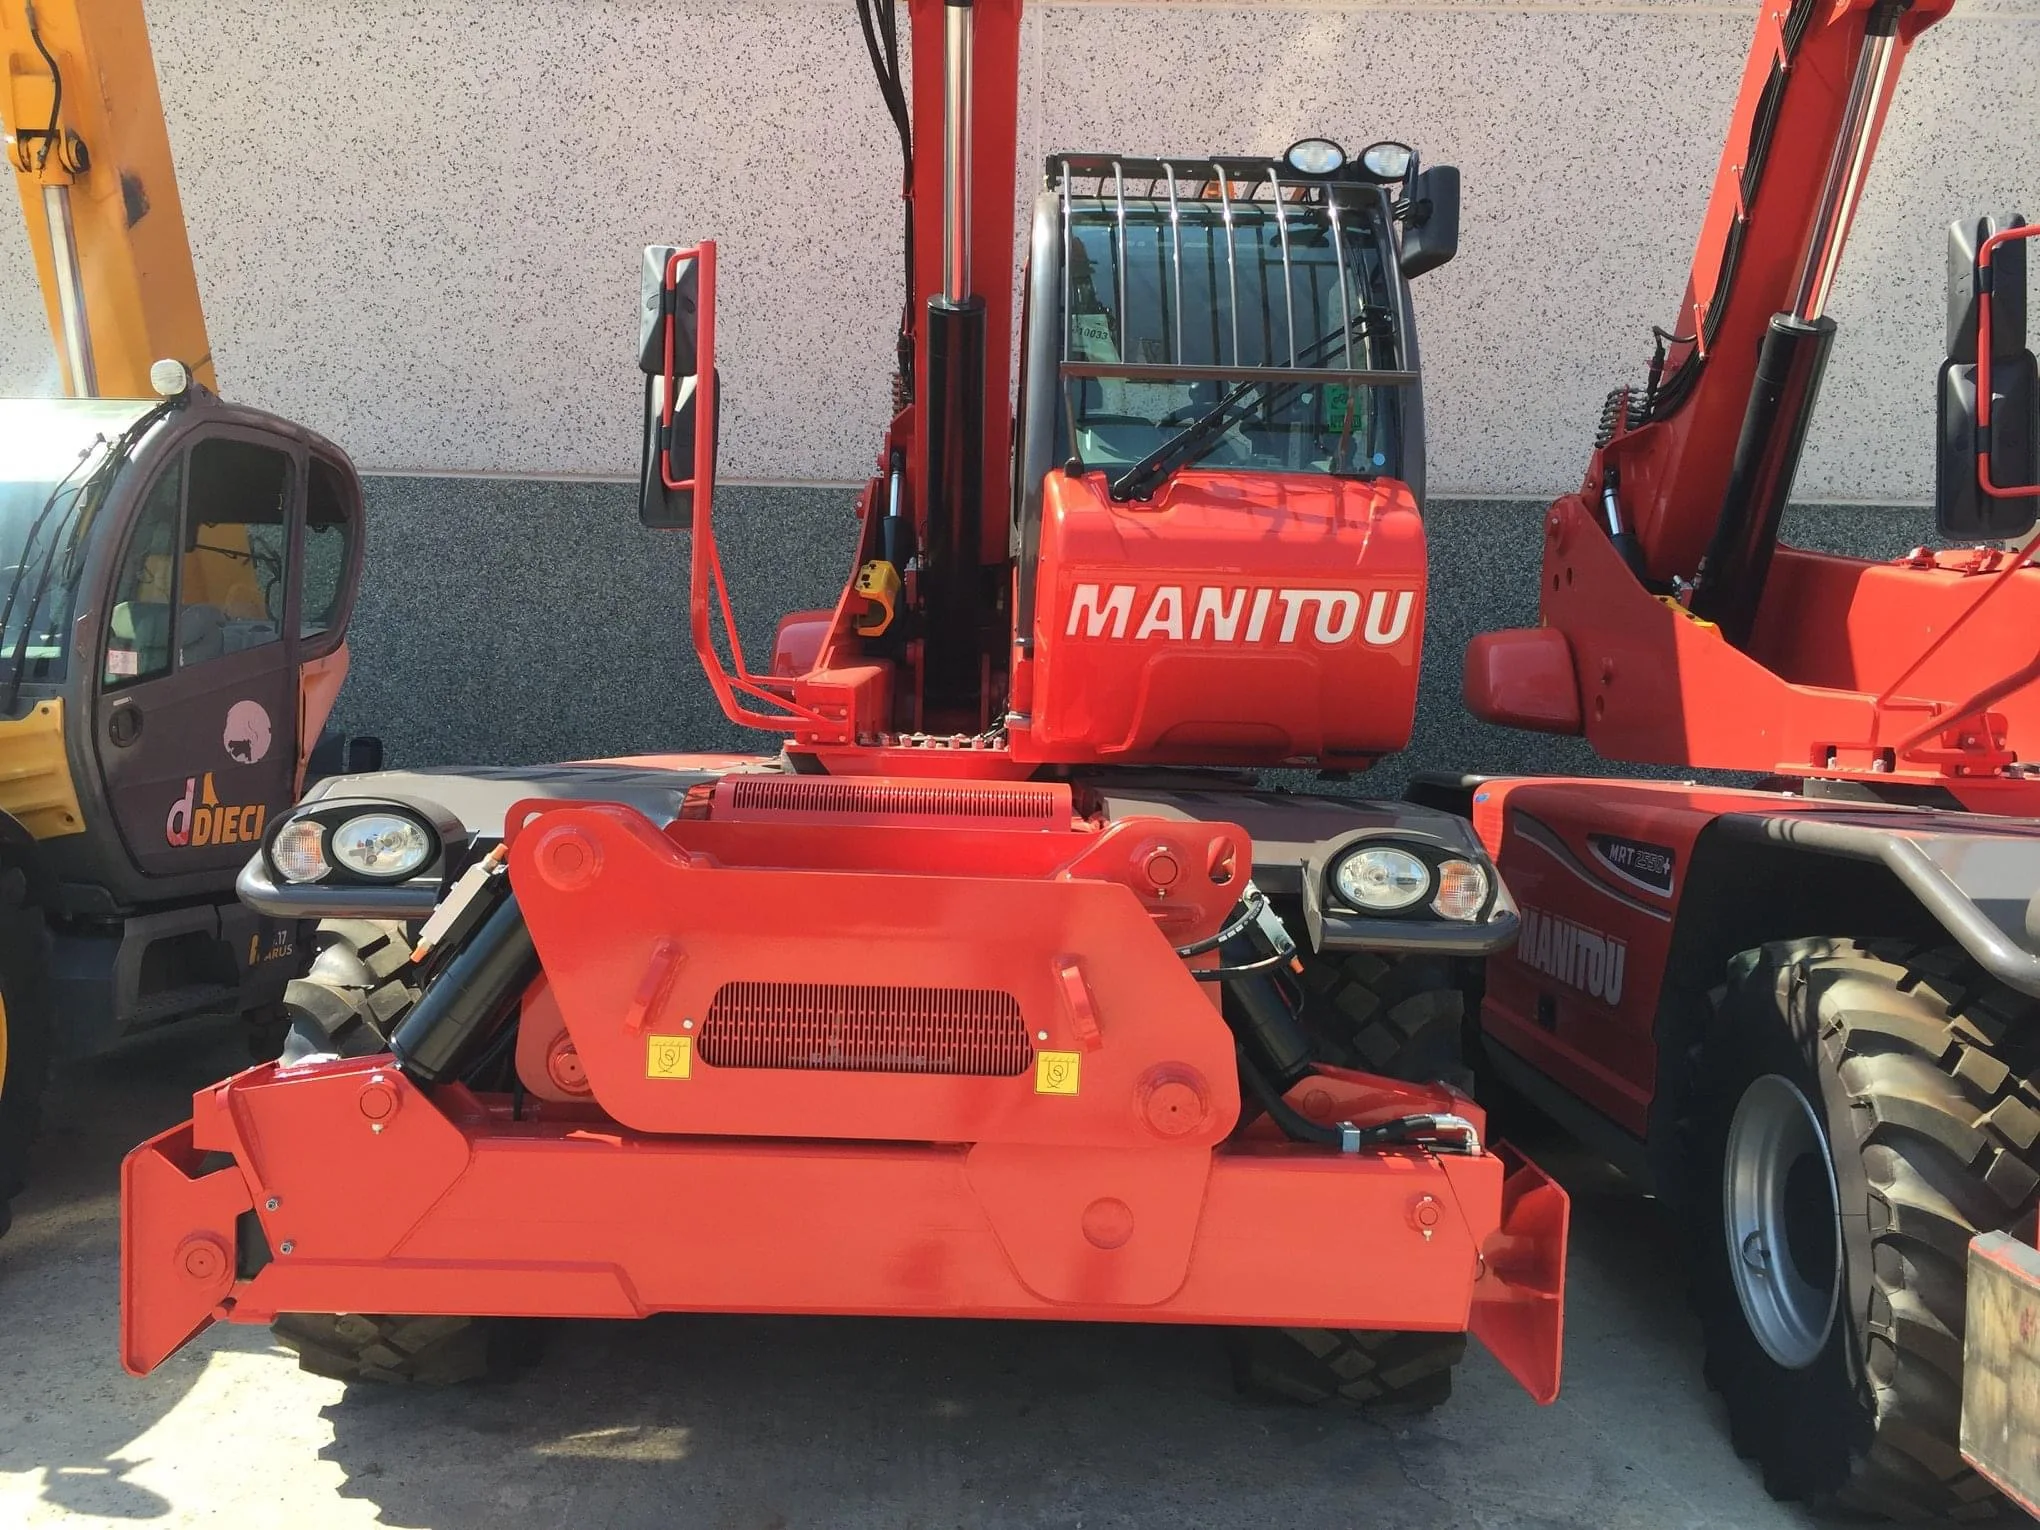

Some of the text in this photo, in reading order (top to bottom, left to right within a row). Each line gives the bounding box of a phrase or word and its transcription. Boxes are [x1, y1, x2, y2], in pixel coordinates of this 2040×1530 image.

[1065, 583, 1414, 645] MANITOU
[1609, 844, 1635, 865] MRT
[1517, 906, 1626, 1006] MANITOU
